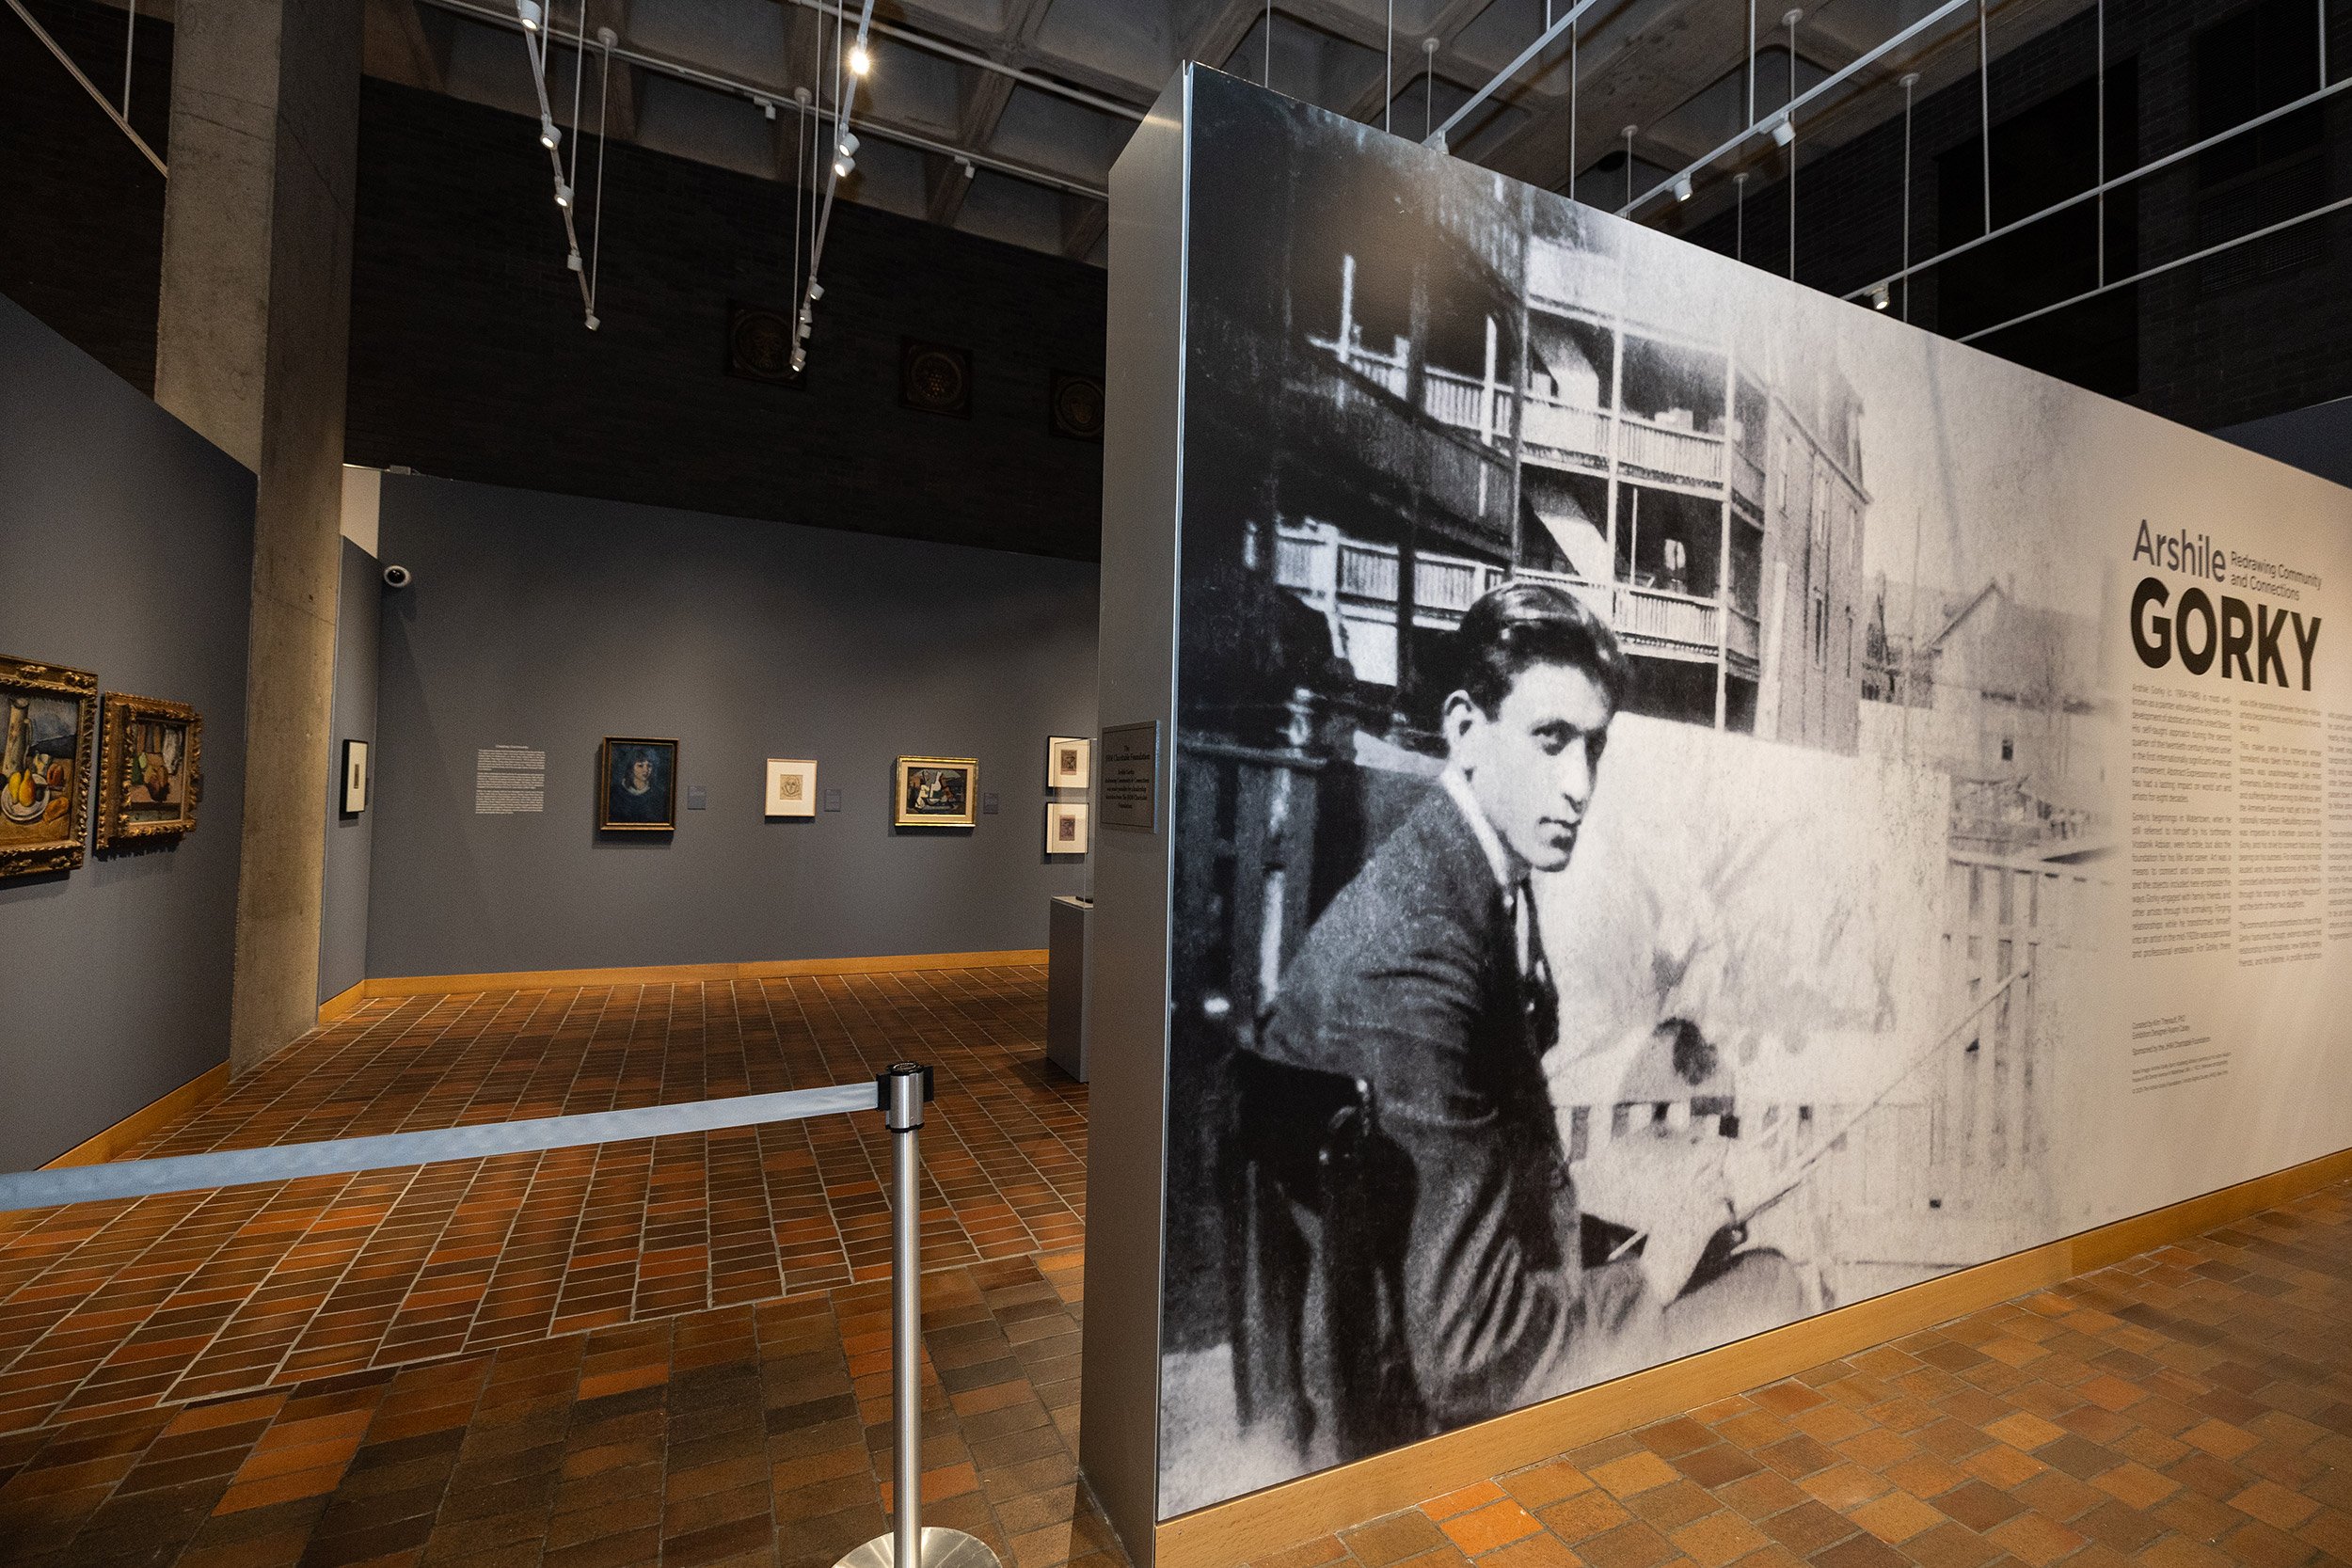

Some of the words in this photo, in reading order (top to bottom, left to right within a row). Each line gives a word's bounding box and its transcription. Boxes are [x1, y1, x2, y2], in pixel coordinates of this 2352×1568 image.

[2133, 519, 2226, 582] Arshile
[2231, 550, 2277, 578] Redrawing
[2279, 563, 2322, 590] Community
[2231, 574, 2248, 588] and
[2251, 576, 2300, 601] Connections
[2130, 577, 2322, 692] GORKY
